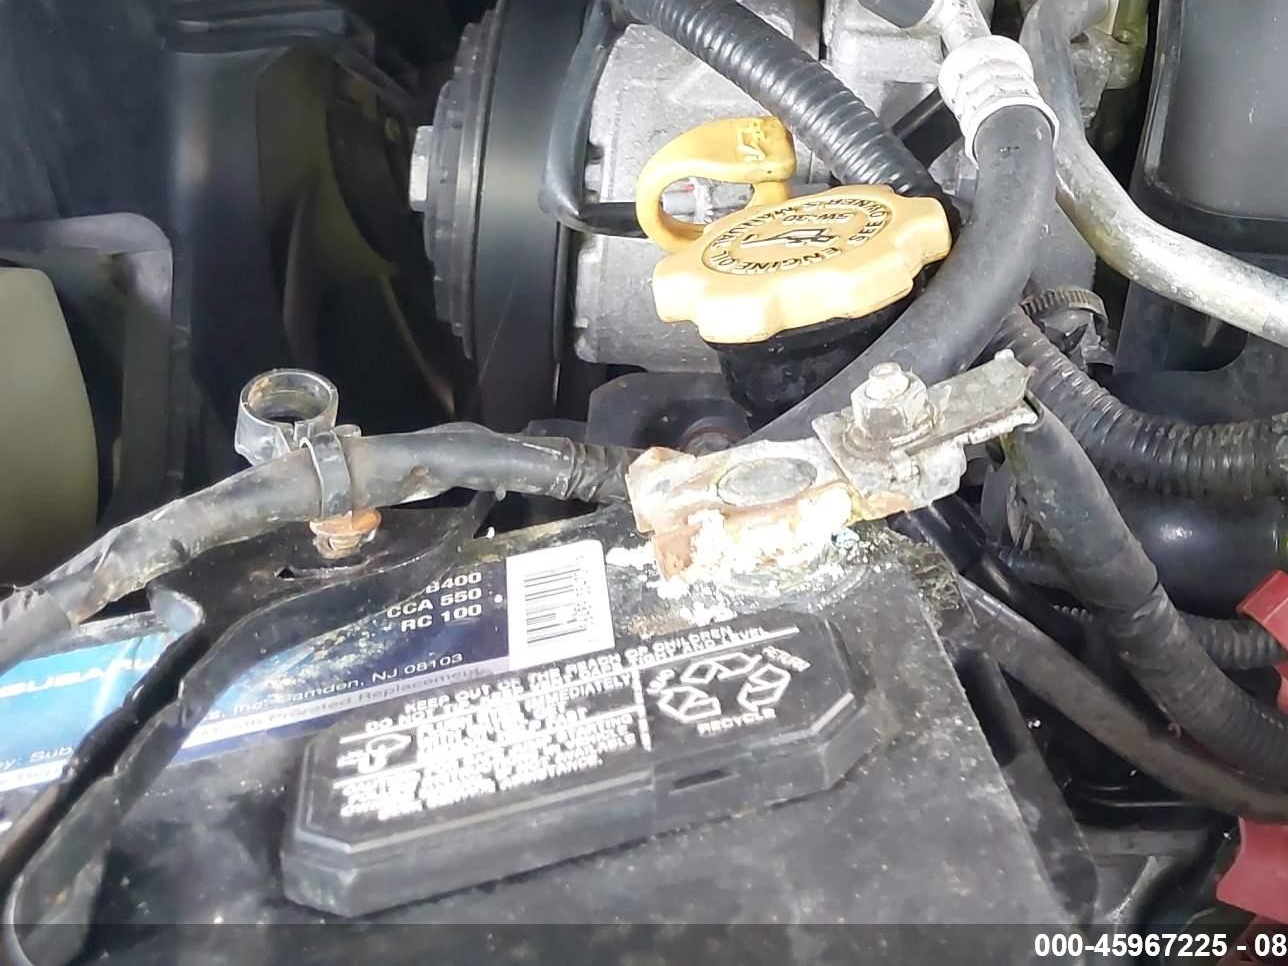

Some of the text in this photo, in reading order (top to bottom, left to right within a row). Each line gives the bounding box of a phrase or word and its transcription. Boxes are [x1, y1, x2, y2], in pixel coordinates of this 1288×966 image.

[712, 206, 796, 248] MANUAL
[847, 220, 883, 245] SEE
[708, 246, 842, 275] ENGINE OIL
[386, 588, 482, 618] CCA 550
[401, 604, 482, 632] RC 100
[372, 668, 398, 683] NJ
[404, 652, 464, 675] 08103
[405, 695, 449, 714] KEEP
[455, 685, 491, 702] OUT
[528, 666, 560, 685] THE
[565, 652, 621, 673] REACH
[652, 626, 733, 652] CHILDREN
